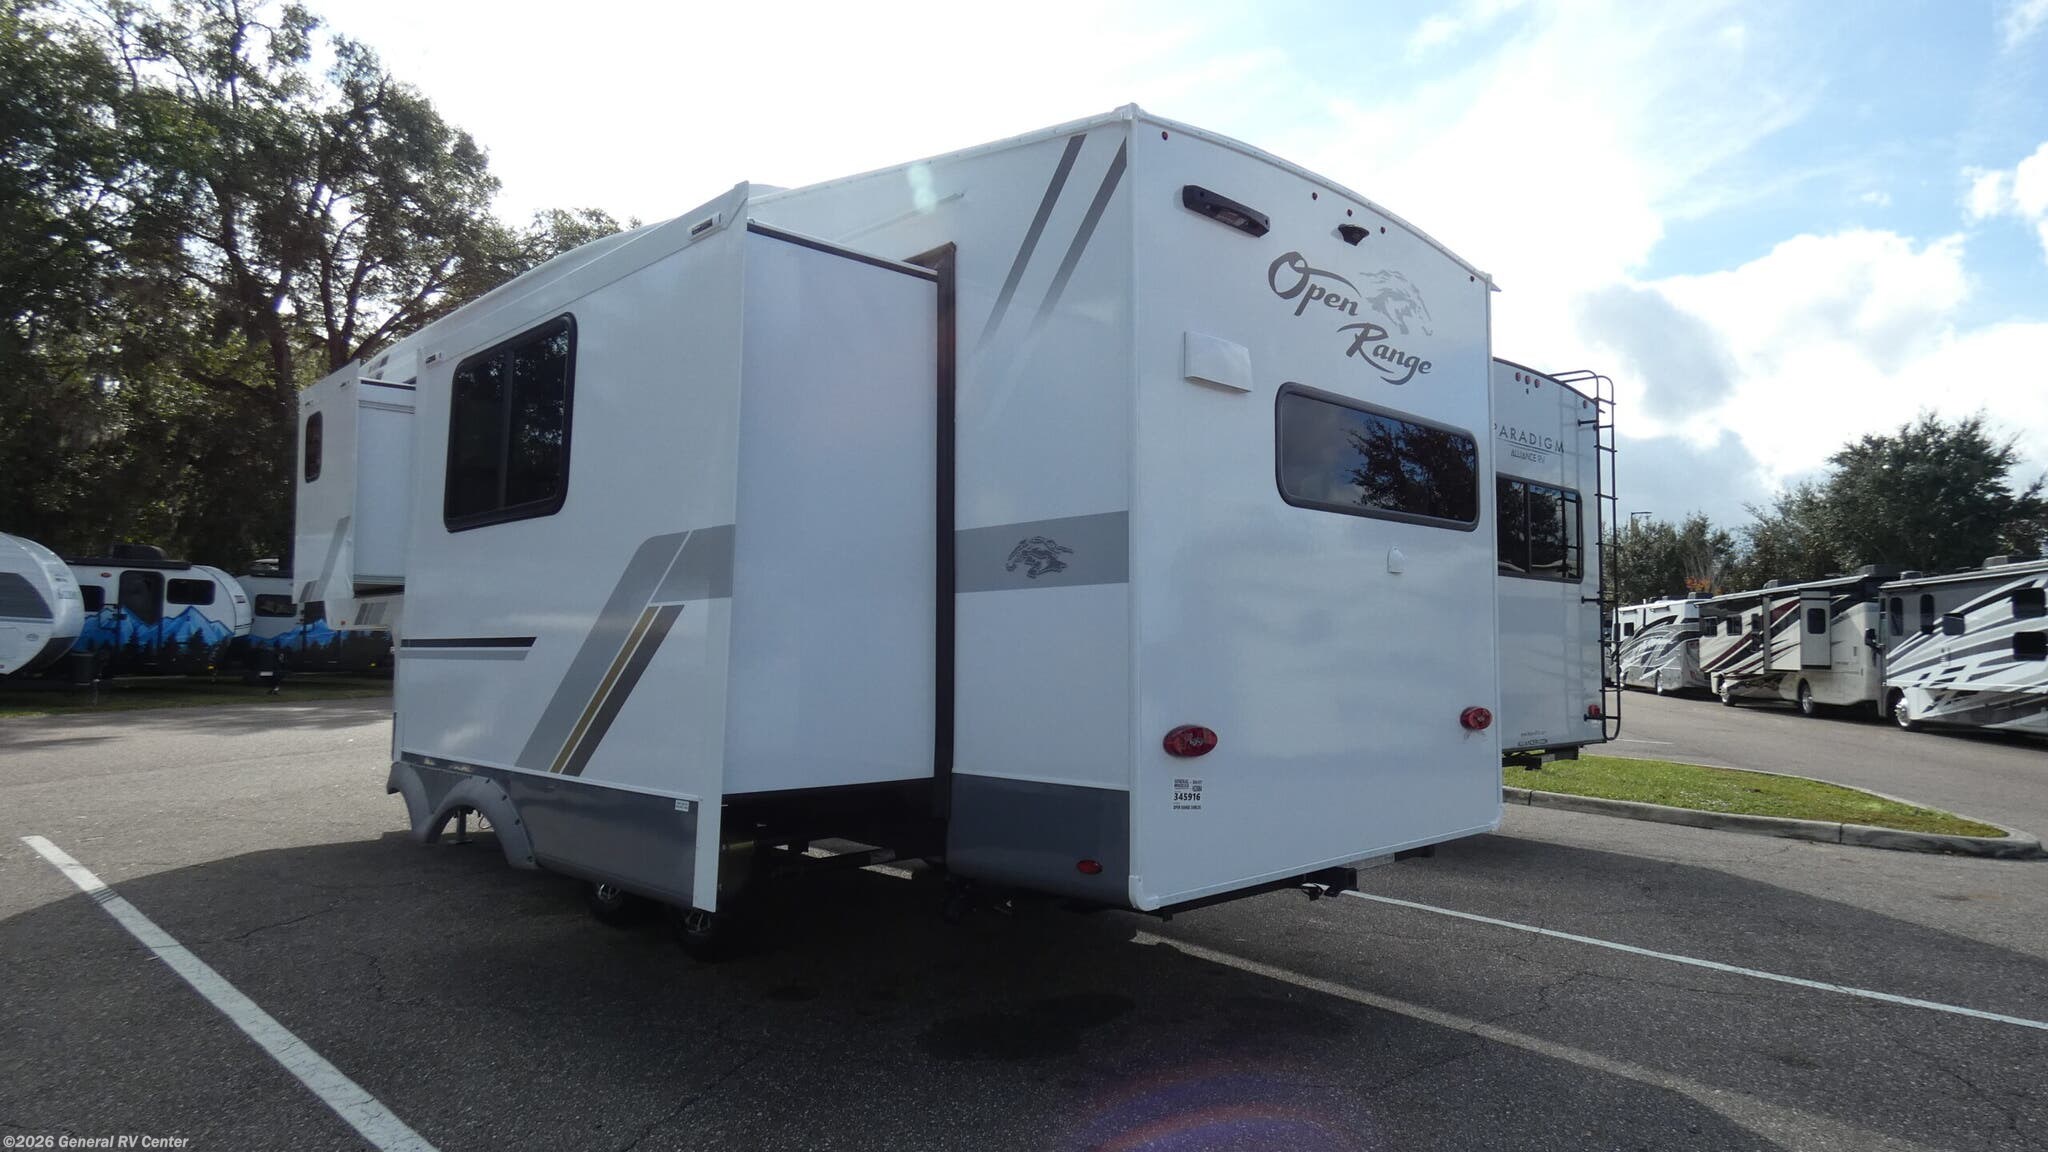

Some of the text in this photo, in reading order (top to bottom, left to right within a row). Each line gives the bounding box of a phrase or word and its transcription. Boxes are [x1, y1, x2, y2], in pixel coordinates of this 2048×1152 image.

[1268, 251, 1361, 316] Open
[1336, 322, 1432, 385] Range
[1511, 447, 1537, 463] ALLIANCE
[1174, 792, 1200, 800] 345916
